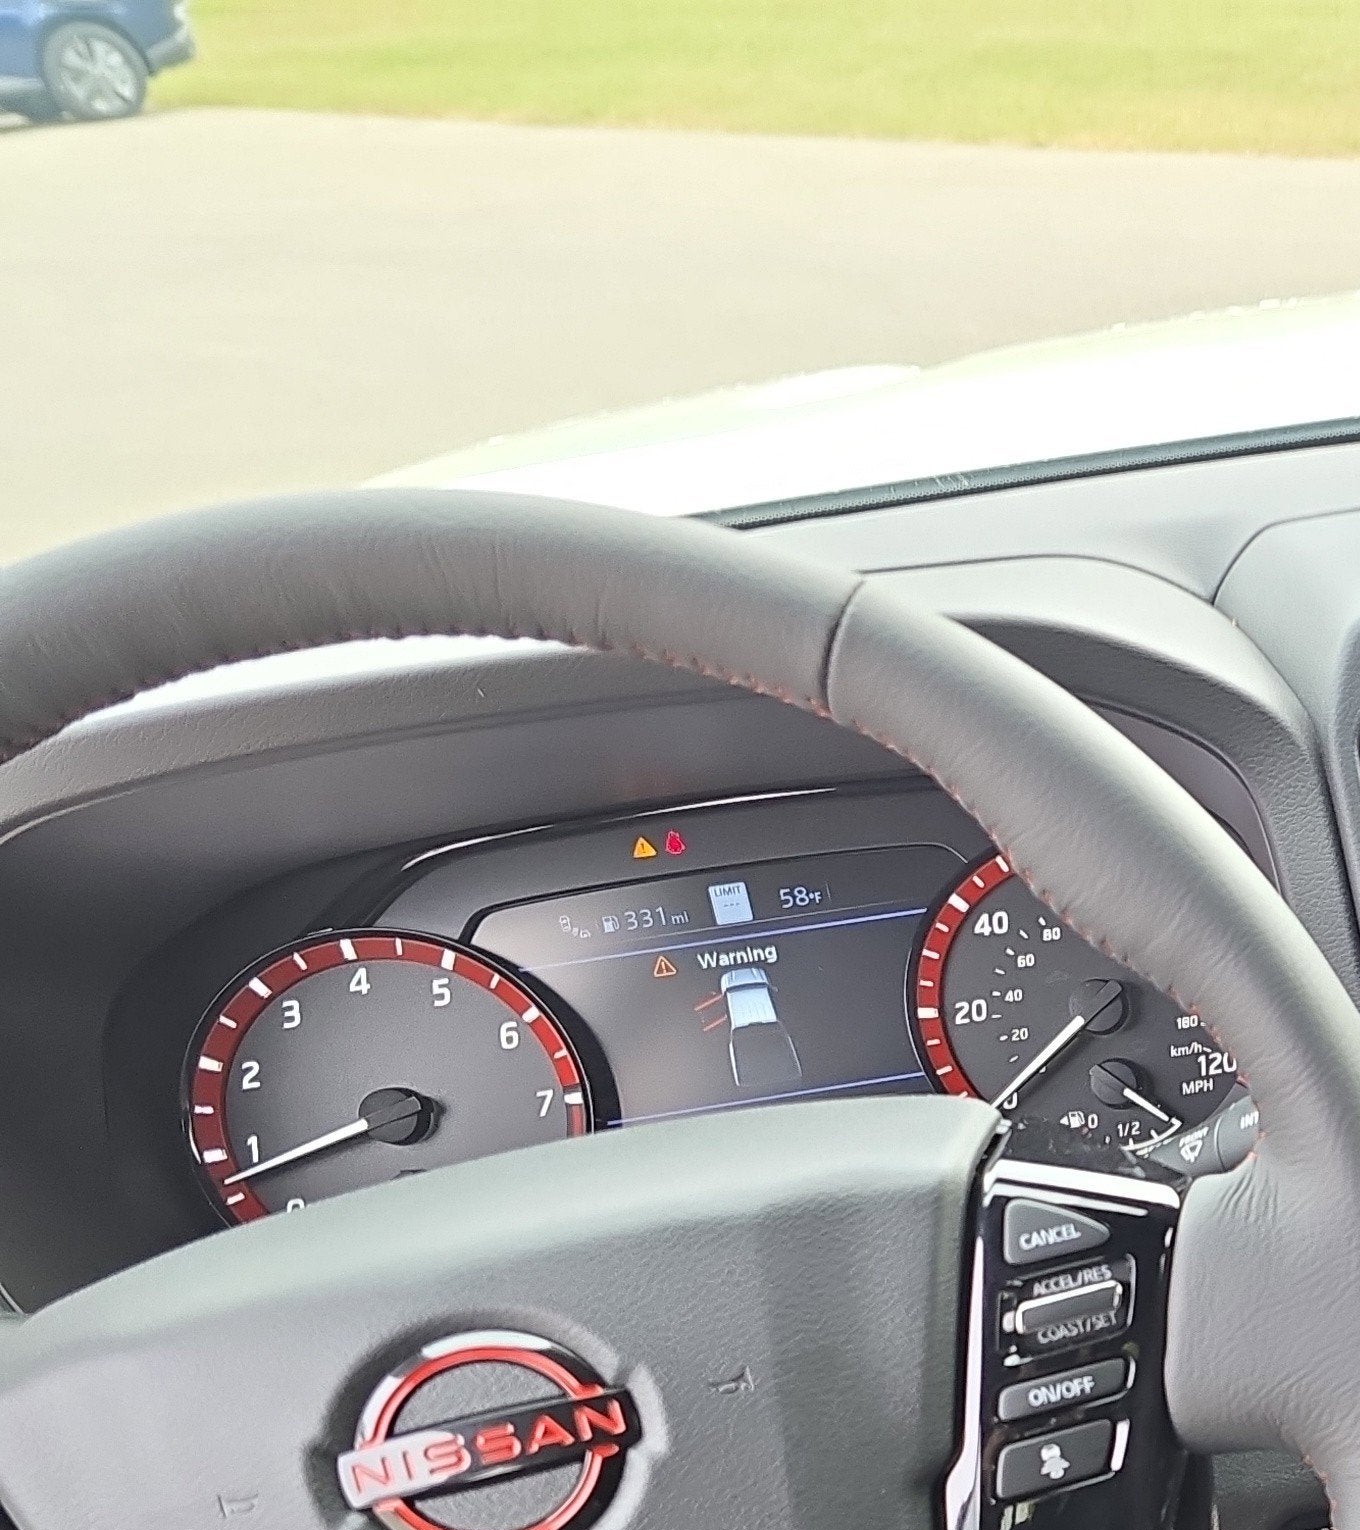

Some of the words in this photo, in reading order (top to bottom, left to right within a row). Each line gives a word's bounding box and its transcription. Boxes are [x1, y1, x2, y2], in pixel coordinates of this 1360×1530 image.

[713, 883, 742, 898] LIMIT
[627, 907, 668, 931] 331
[973, 910, 1010, 936] 40
[1042, 926, 1062, 942] 80
[698, 944, 779, 971] Warning
[1016, 953, 1036, 968] 60
[349, 968, 371, 996] 4
[431, 978, 452, 1006] 5
[1004, 988, 1024, 1003] 40
[282, 1000, 302, 1029] 3
[954, 999, 989, 1025] 20
[499, 1022, 520, 1049] 6
[1011, 1027, 1029, 1042] 20
[1170, 1041, 1202, 1058] km/h
[241, 1062, 261, 1090] 2
[1197, 1052, 1237, 1077] 120
[1182, 1078, 1214, 1095] MPH
[536, 1089, 554, 1118] 7
[1087, 1113, 1098, 1129] 0
[1117, 1121, 1141, 1137] 1/2
[246, 1134, 260, 1164] 1
[1019, 1222, 1082, 1251] CANCEL
[1032, 1264, 1113, 1297] ACCEL/RES
[1036, 1311, 1118, 1345] COAST/SET
[1027, 1375, 1096, 1408] ON/OFF
[350, 1398, 627, 1495] NISSAN
